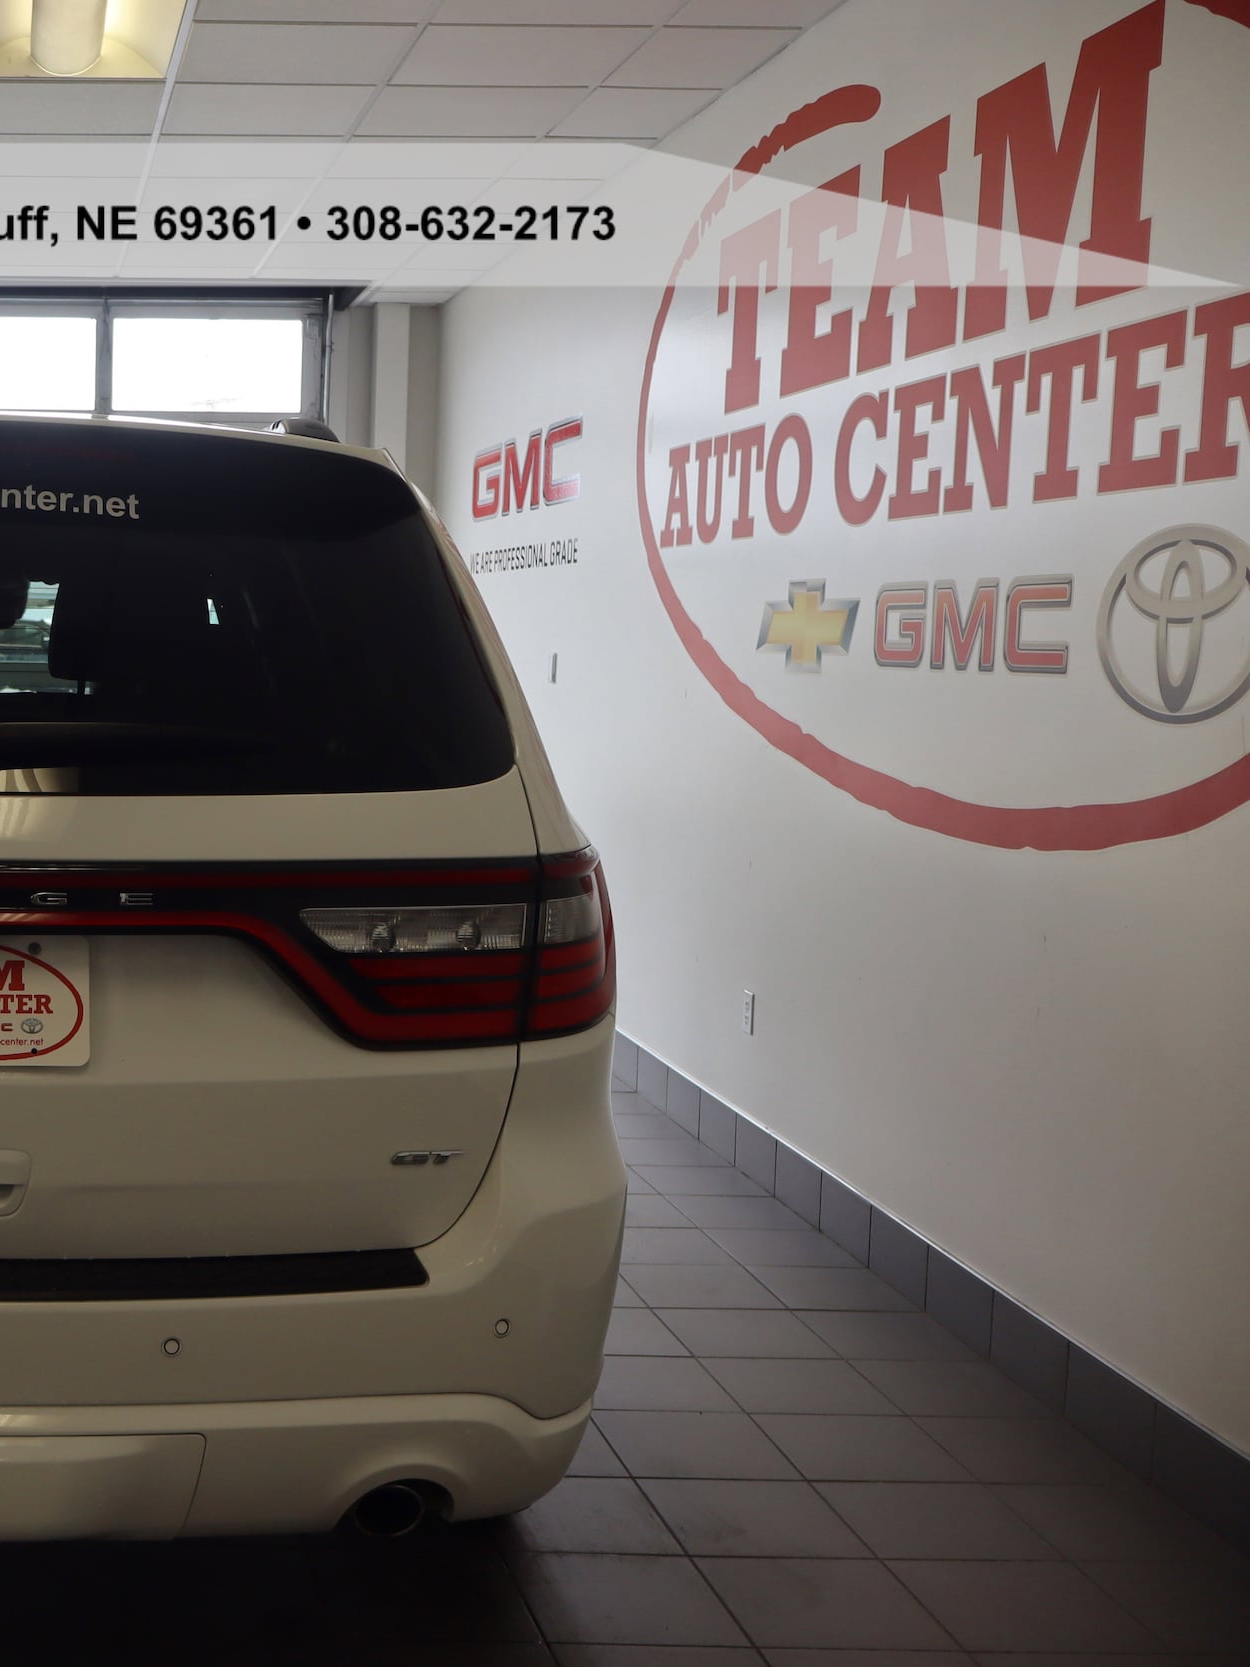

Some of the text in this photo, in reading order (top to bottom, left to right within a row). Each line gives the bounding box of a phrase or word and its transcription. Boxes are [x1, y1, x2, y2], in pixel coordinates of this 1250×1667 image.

[717, 2, 1164, 414] TEAM
[472, 412, 583, 523] GMC
[660, 412, 813, 548] AUTO
[480, 549, 493, 574] ARE
[494, 541, 548, 572] PROFESSIONAL
[550, 538, 578, 566] GRADE
[874, 574, 1073, 674] GMC
[391, 1150, 463, 1165] GT
